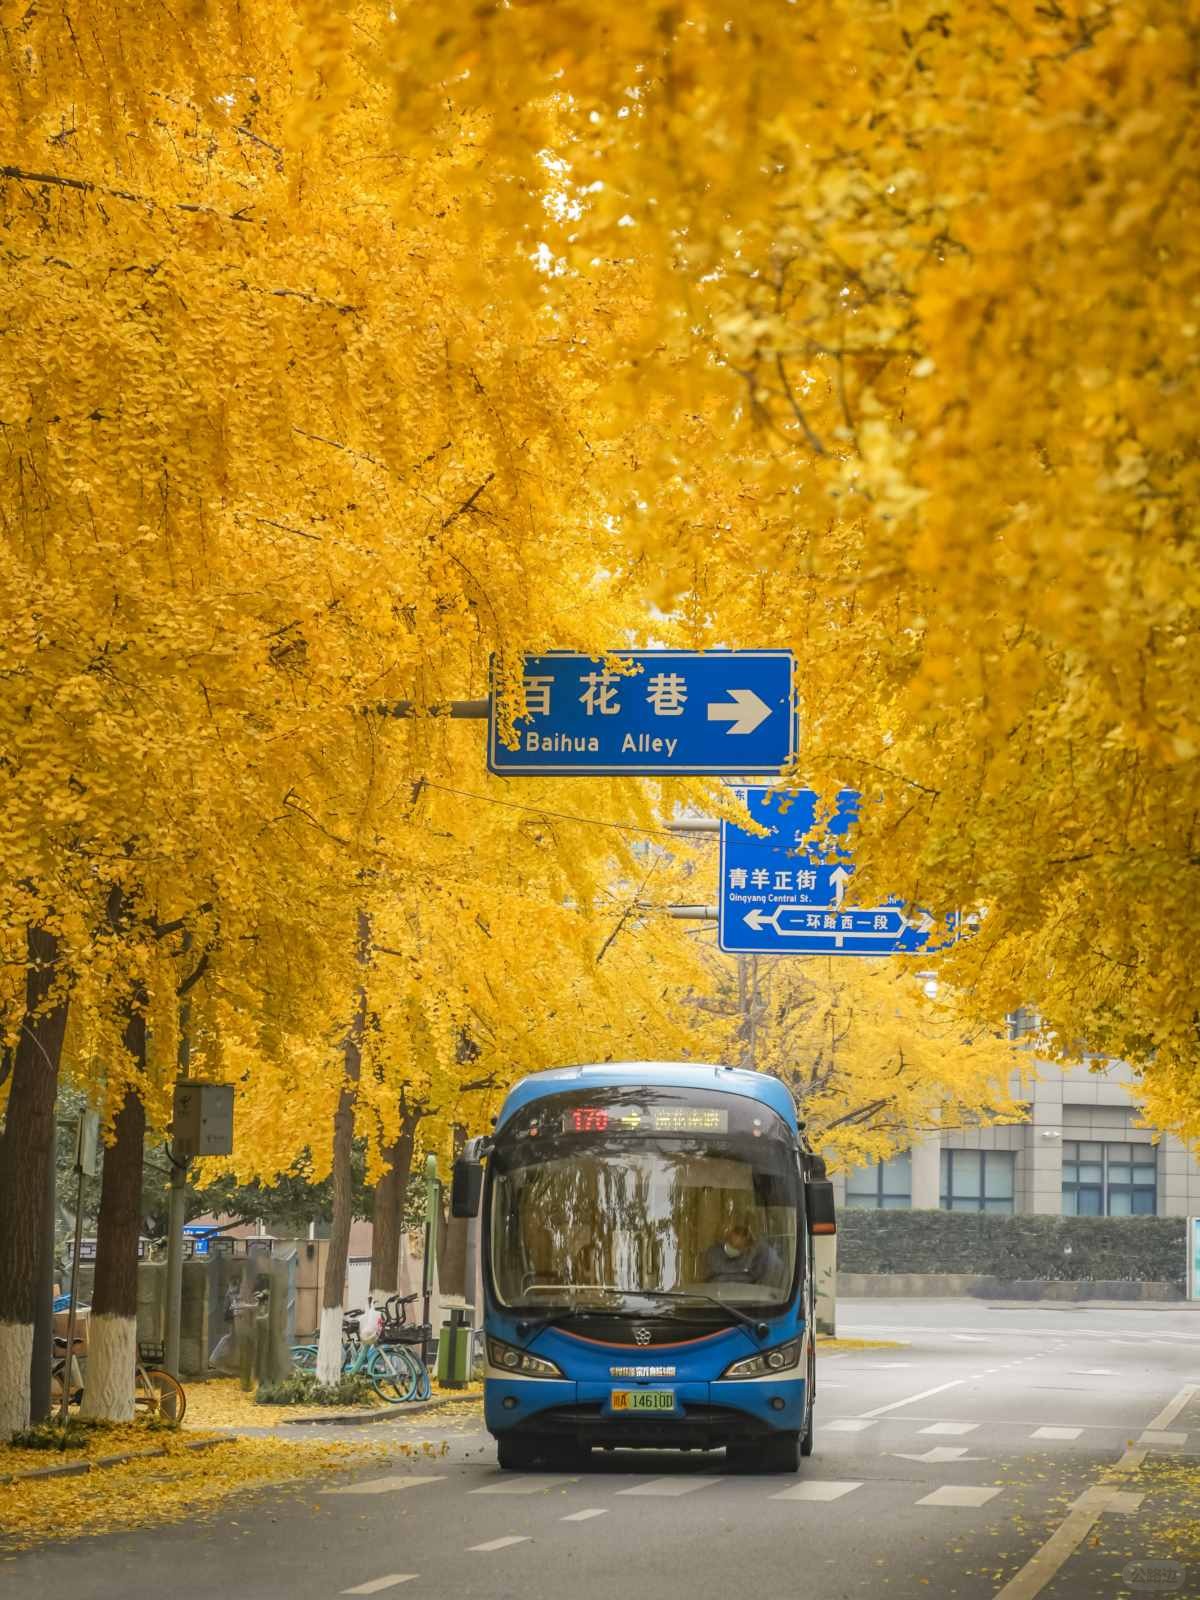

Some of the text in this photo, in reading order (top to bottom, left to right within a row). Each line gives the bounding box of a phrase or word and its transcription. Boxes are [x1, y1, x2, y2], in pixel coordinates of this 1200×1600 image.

[523, 672, 688, 716] 百花巷
[526, 732, 678, 757] Baihua Alley
[728, 868, 817, 891] 青羊正街
[729, 893, 812, 904] Qingyang Central St.
[789, 913, 889, 931] 一环路西一段
